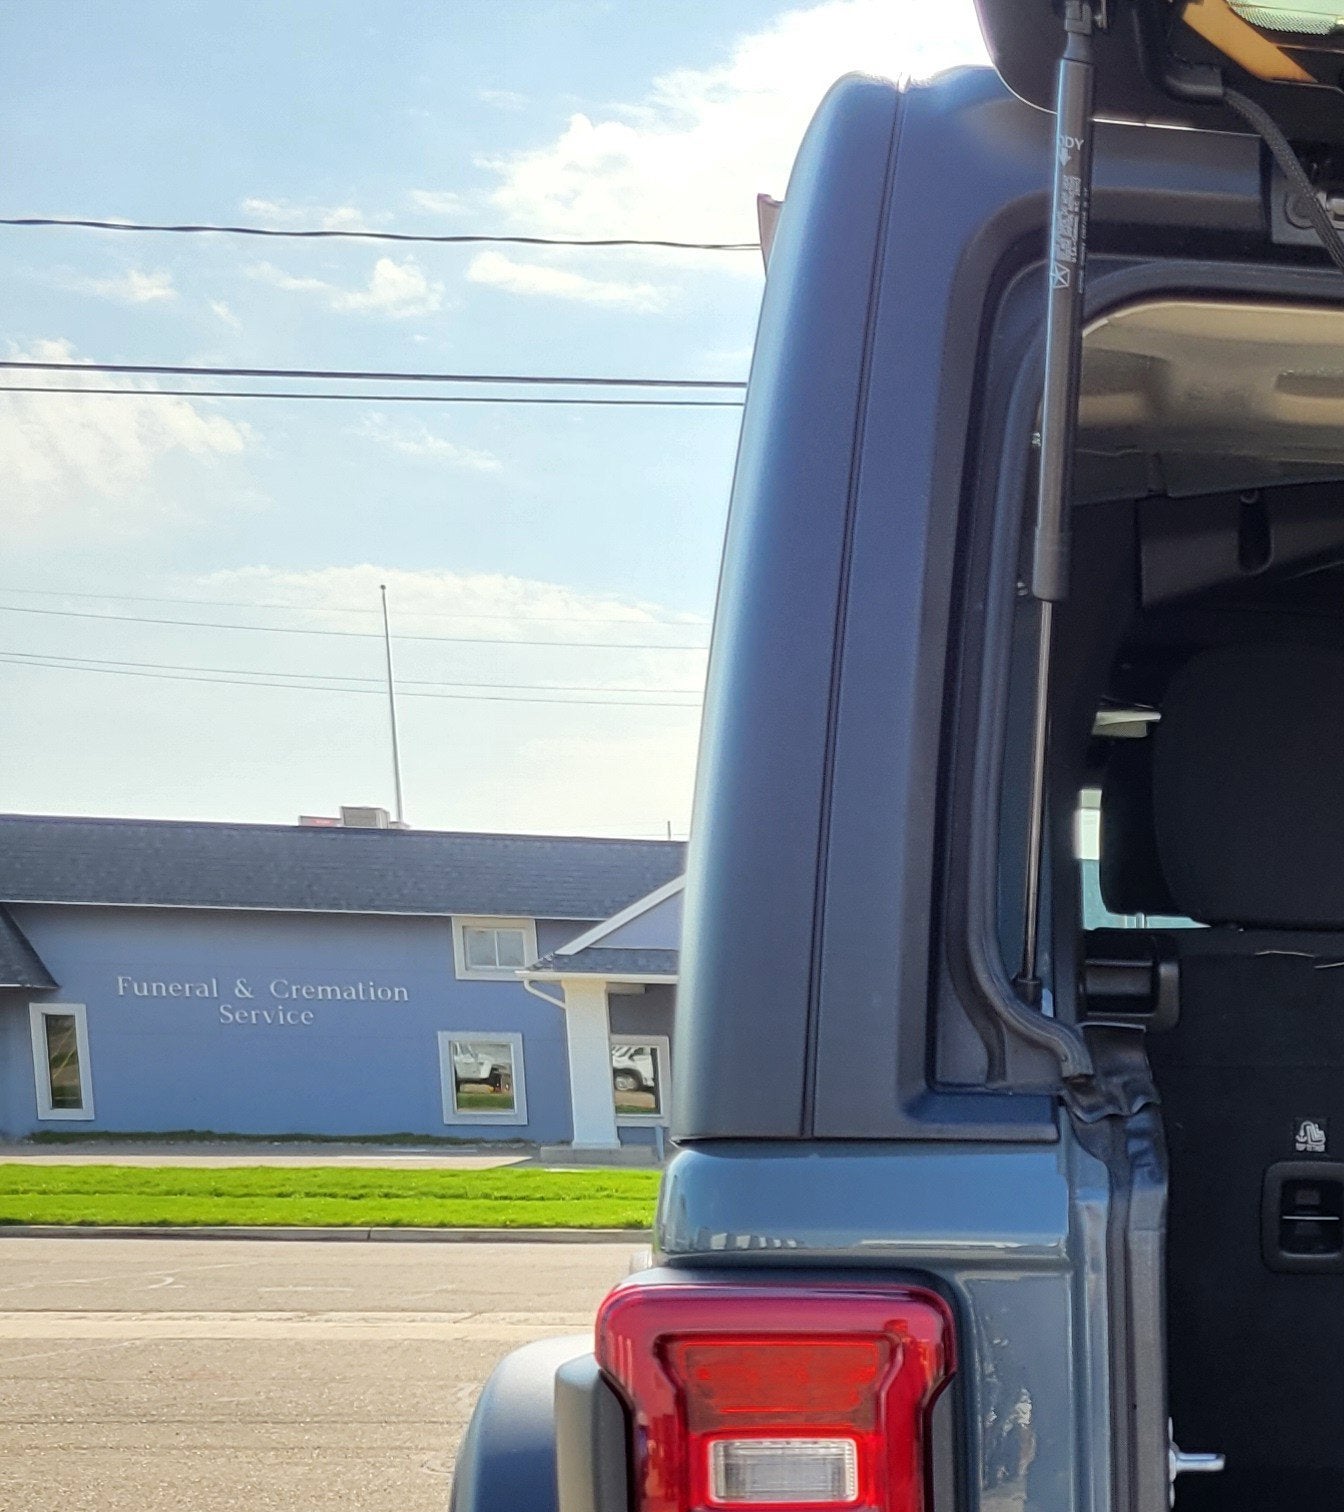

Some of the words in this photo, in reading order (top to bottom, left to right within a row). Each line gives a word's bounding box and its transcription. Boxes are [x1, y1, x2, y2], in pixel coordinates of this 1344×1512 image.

[117, 976, 219, 998] Funeral
[234, 979, 254, 998] &
[270, 979, 409, 1001] Cremation
[219, 1004, 315, 1025] Service
